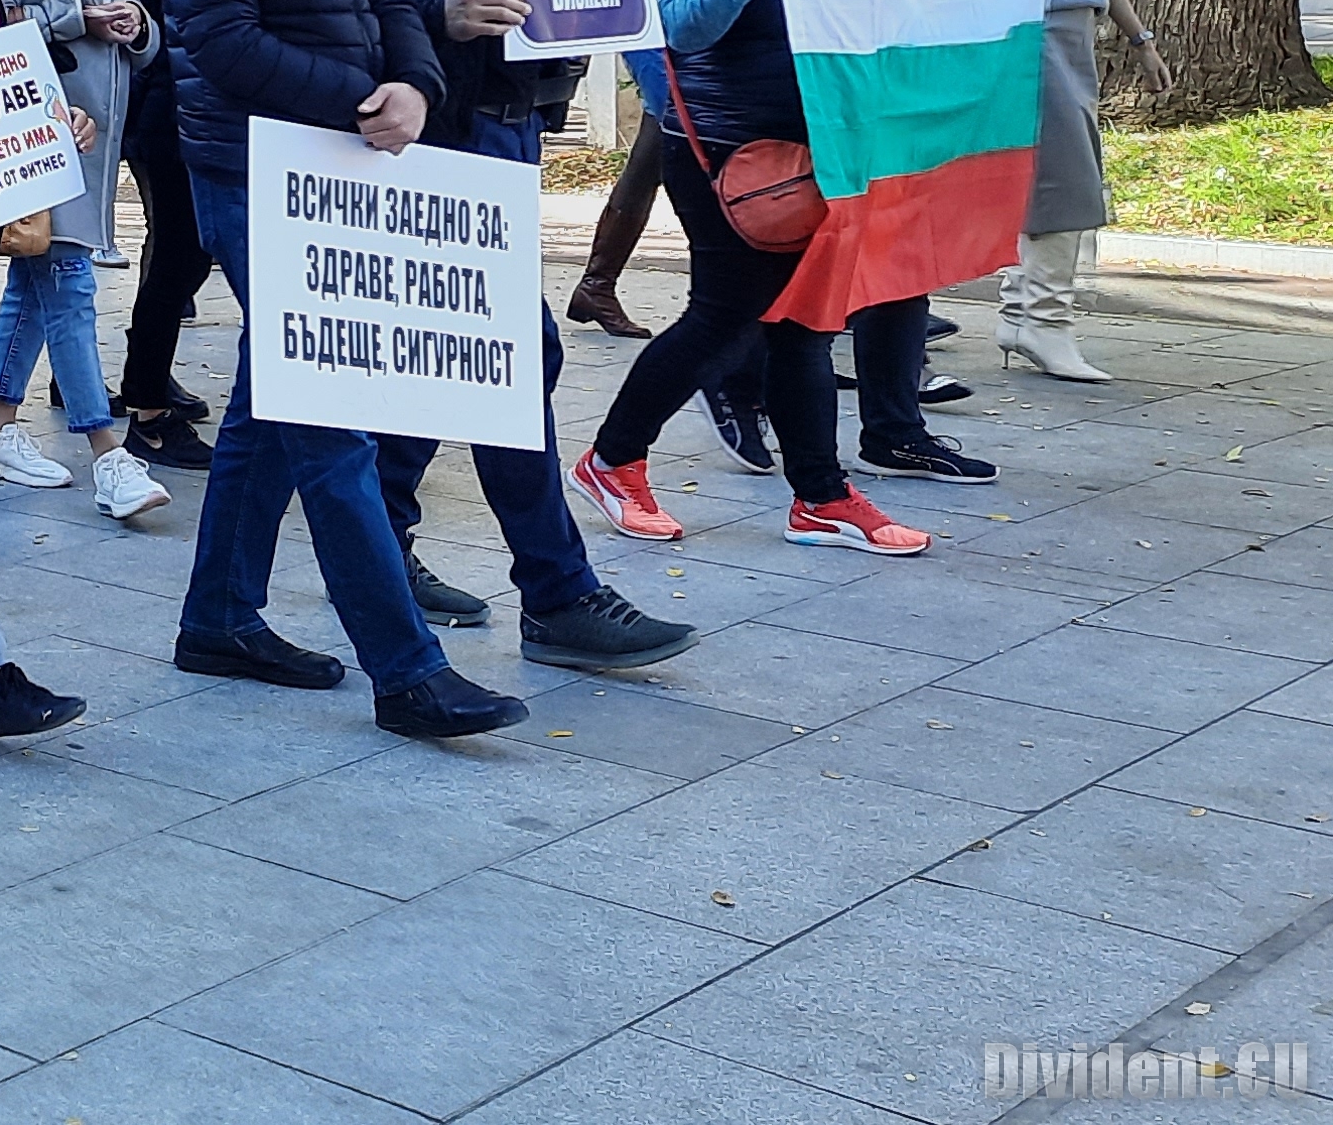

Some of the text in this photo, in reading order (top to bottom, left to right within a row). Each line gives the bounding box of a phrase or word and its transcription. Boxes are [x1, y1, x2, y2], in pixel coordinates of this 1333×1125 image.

[4, 168, 19, 188] ОТ
[19, 152, 67, 183] ФИТНЕС
[23, 124, 60, 151] ИМА
[285, 170, 511, 252] ВСИЧКИ ЗАЕДНО ЗА:
[305, 243, 494, 322] ЗДРАВЕ, РАБОТА,
[282, 310, 515, 388] БЪДЕЩЕ, СИГУРНОСТ
